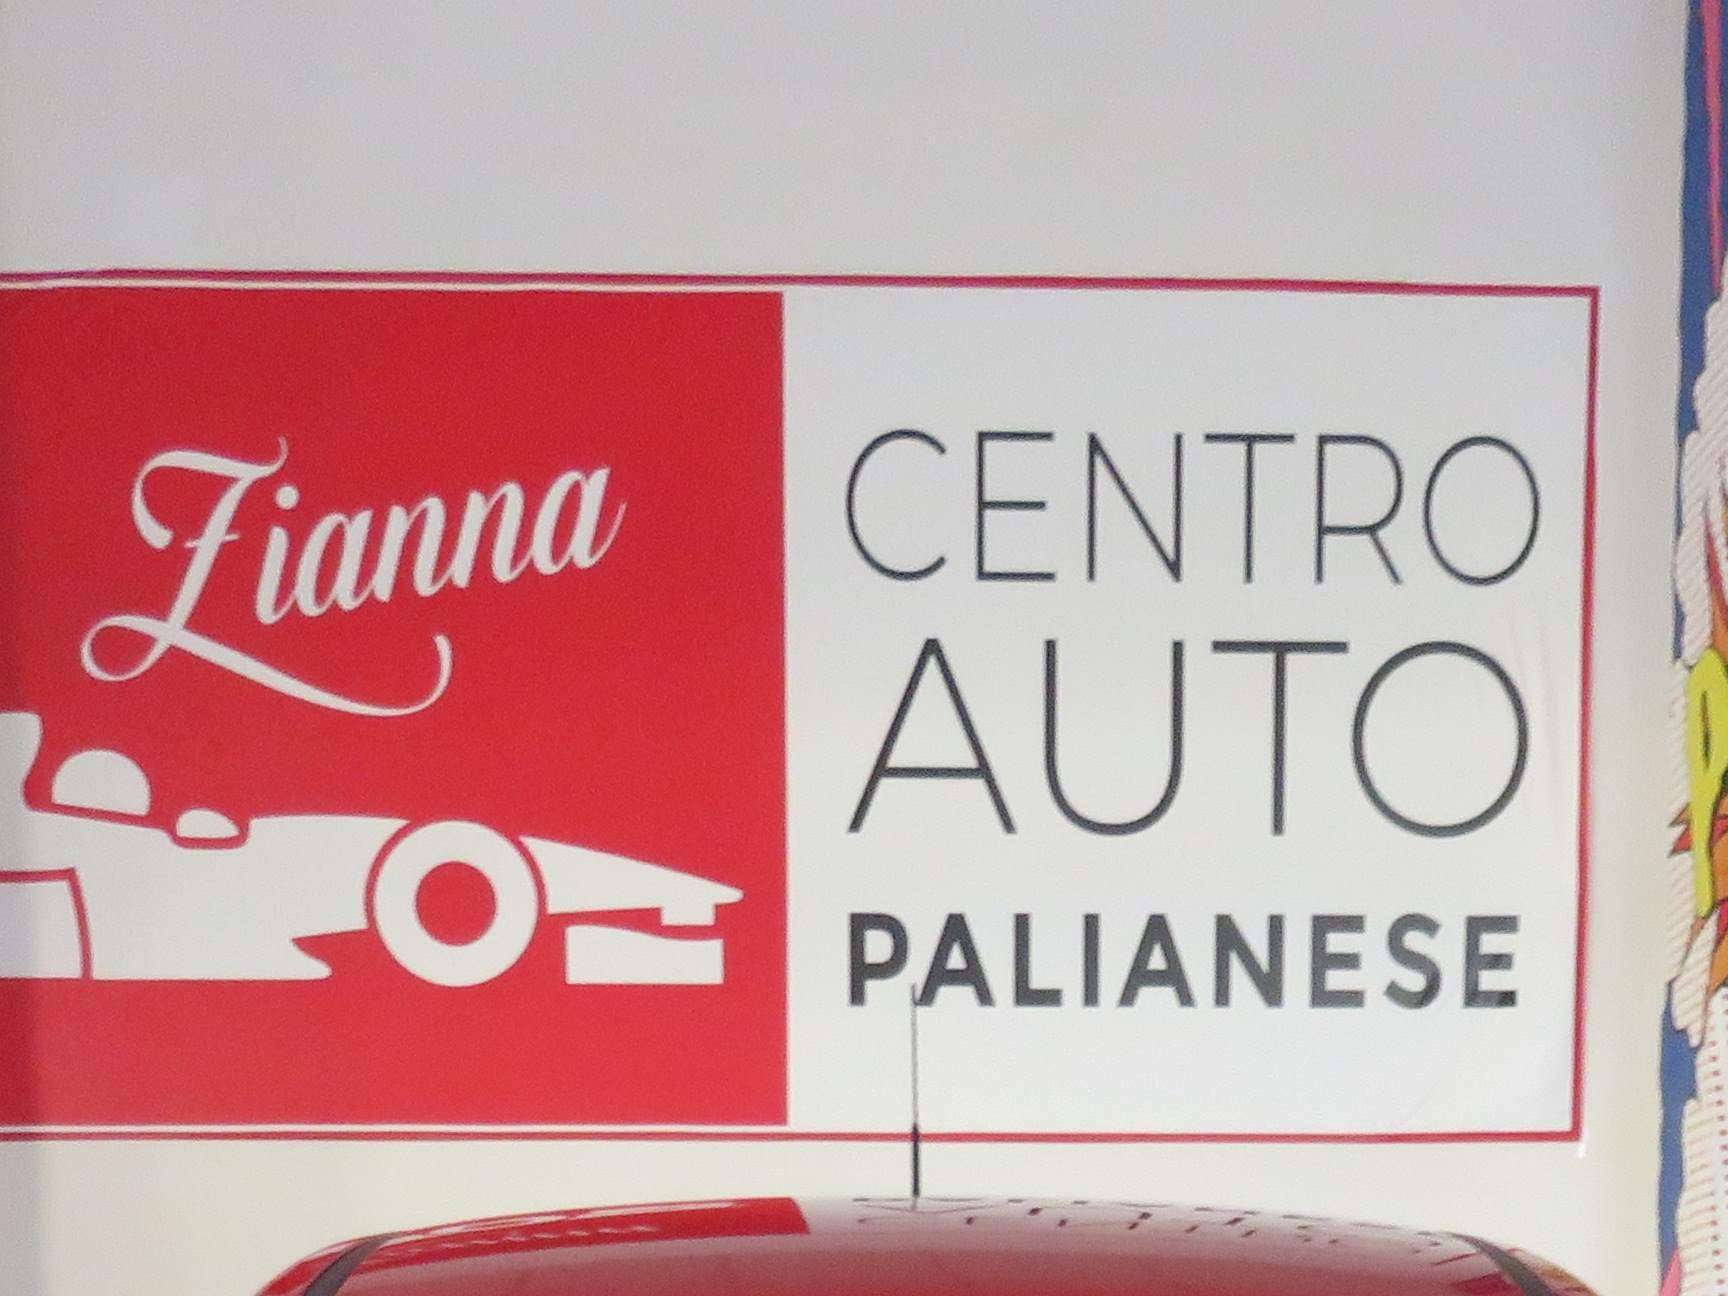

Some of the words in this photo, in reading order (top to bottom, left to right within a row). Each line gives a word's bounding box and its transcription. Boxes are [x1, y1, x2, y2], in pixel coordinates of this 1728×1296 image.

[80, 435, 628, 717] Zianna
[845, 427, 1542, 588] CENTRO
[846, 637, 1531, 840] AUTO
[847, 910, 1522, 1011] PALIANESE
